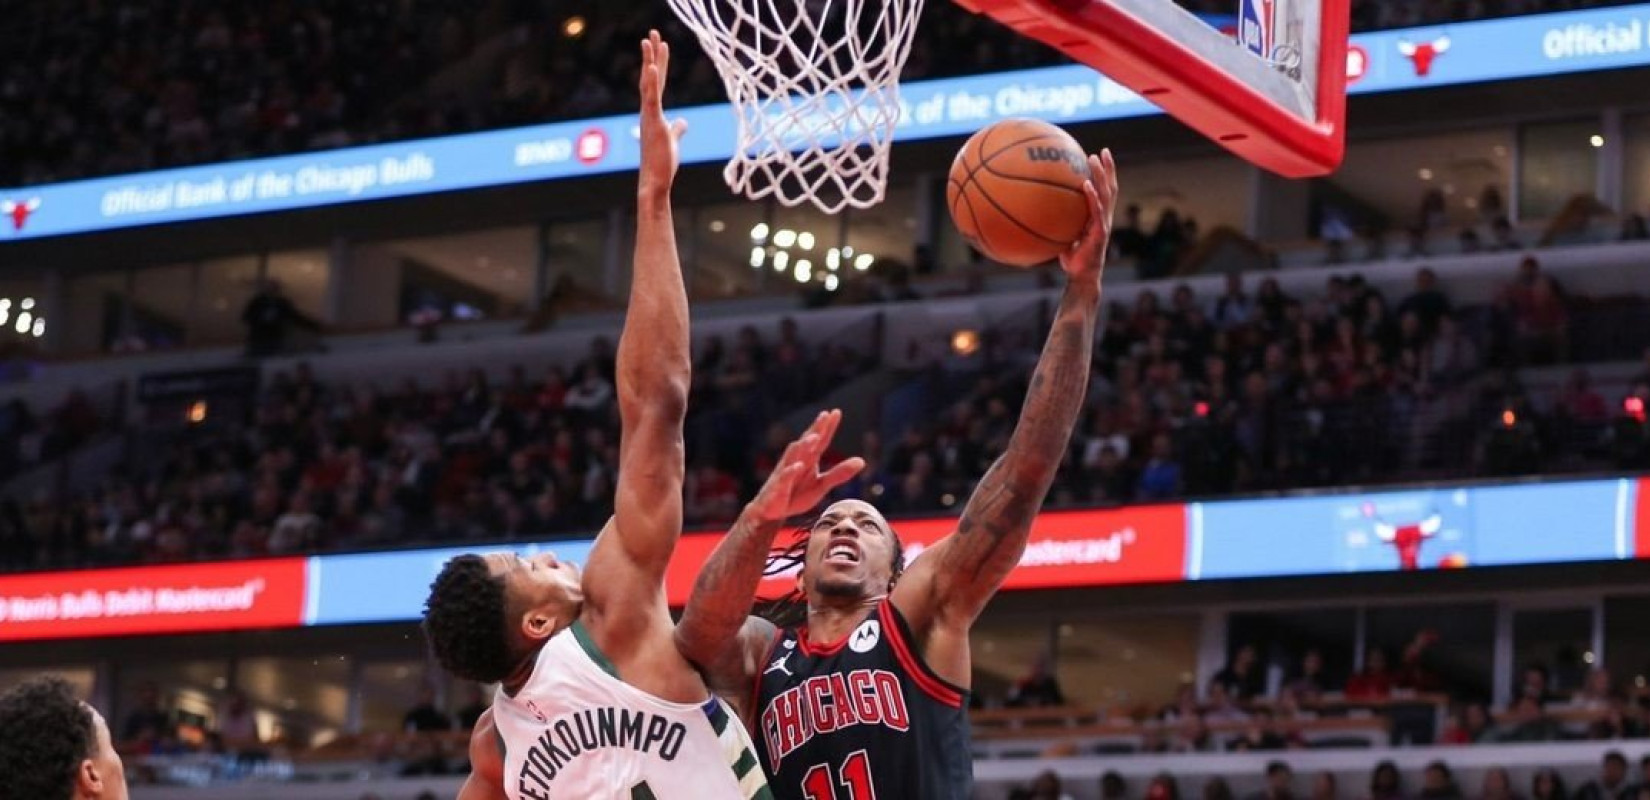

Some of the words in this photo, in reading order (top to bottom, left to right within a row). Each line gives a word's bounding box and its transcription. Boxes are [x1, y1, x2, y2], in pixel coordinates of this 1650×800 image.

[1543, 19, 1641, 59] Official
[916, 93, 945, 121] of
[948, 90, 991, 119] the
[995, 82, 1092, 116] Chicago
[101, 184, 173, 216] Official
[175, 176, 226, 208] Bank
[229, 173, 254, 201] of
[256, 169, 291, 197] the
[296, 164, 377, 195] Chicago
[380, 152, 434, 185] Bulls
[1019, 531, 1122, 566] astercard
[762, 669, 910, 775] CHICAGO
[519, 706, 687, 800] ETOKOUNMPO
